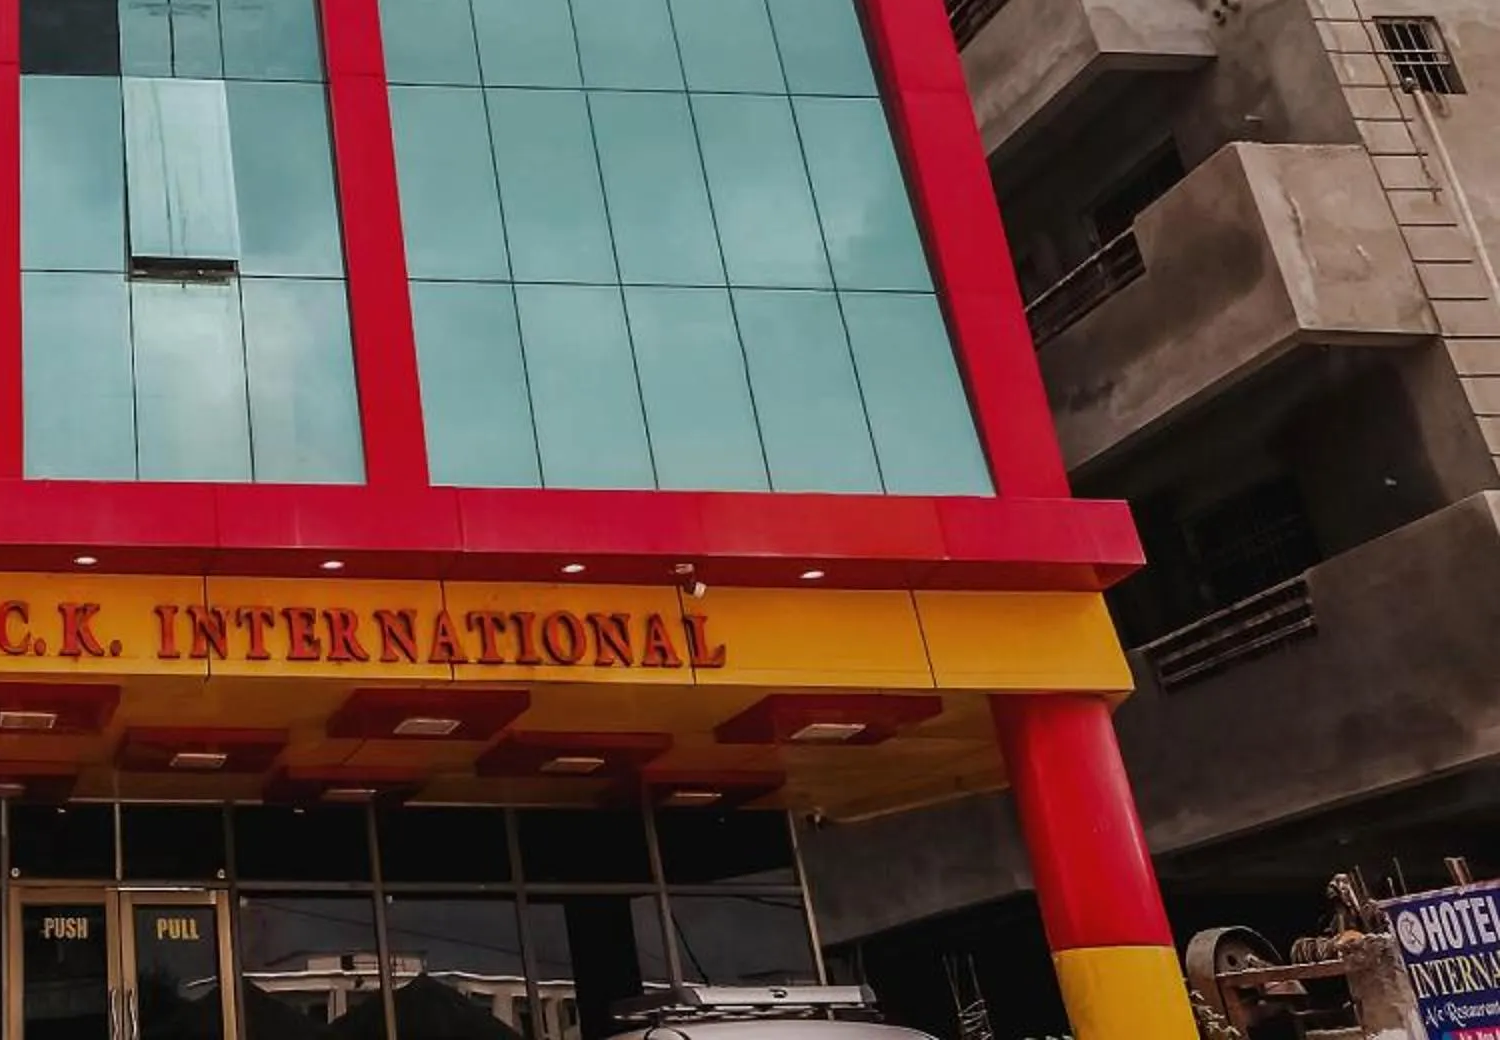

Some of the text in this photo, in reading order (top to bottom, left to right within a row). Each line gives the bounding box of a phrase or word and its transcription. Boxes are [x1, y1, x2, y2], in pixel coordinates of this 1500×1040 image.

[155, 604, 726, 669] INTERNATIONAL
[42, 917, 89, 939] PUSH
[156, 918, 200, 940] PULL
